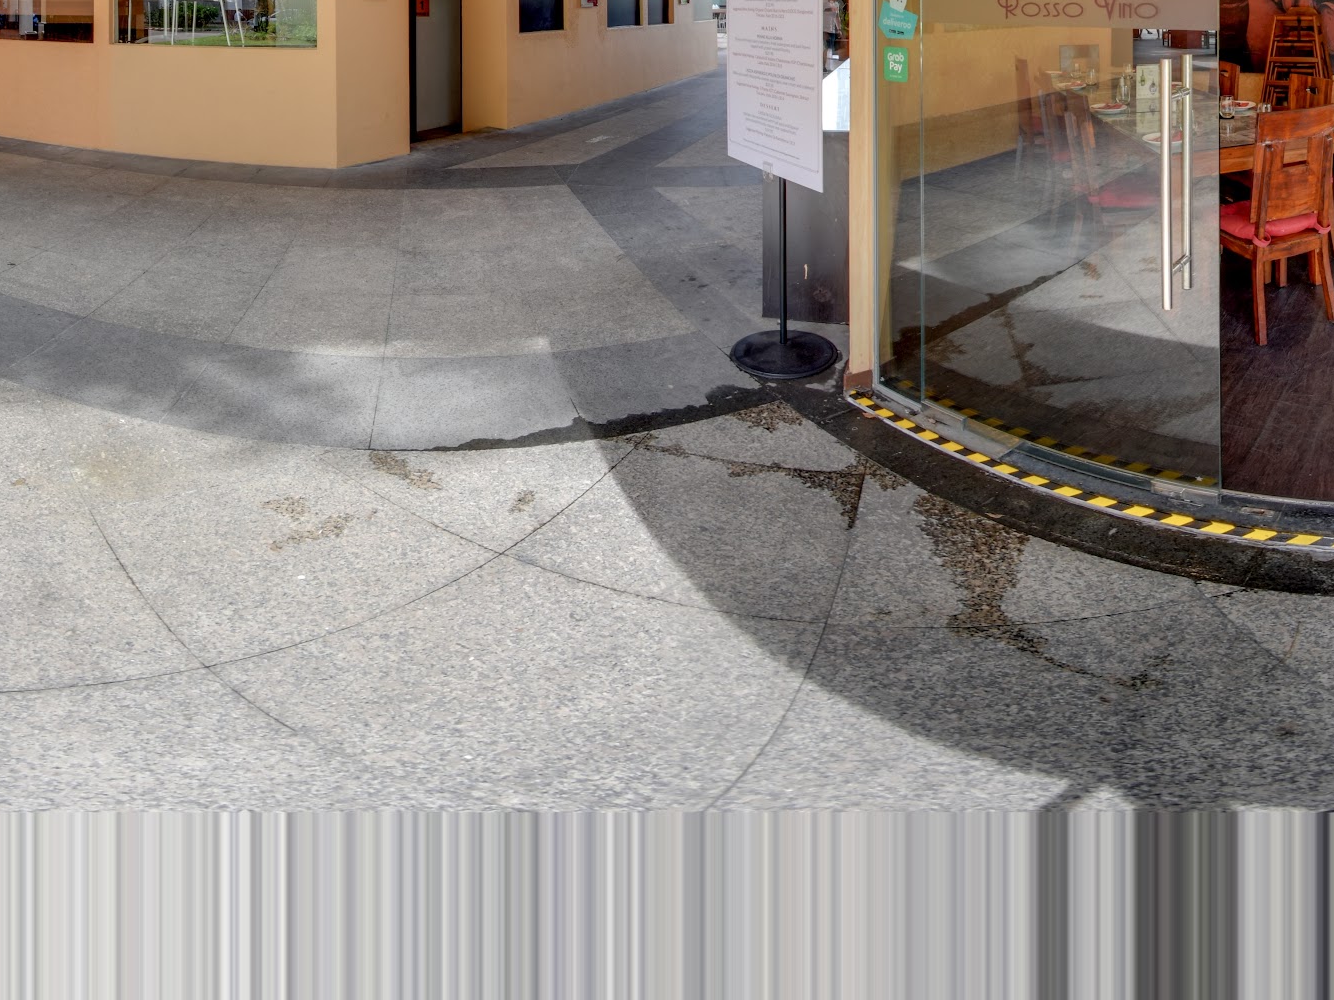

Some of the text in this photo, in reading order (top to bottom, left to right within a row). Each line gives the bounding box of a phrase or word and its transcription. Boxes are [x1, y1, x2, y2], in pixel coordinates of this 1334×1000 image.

[882, 17, 912, 29] deliveroo
[887, 52, 904, 62] Grab
[889, 61, 903, 73] Pay
